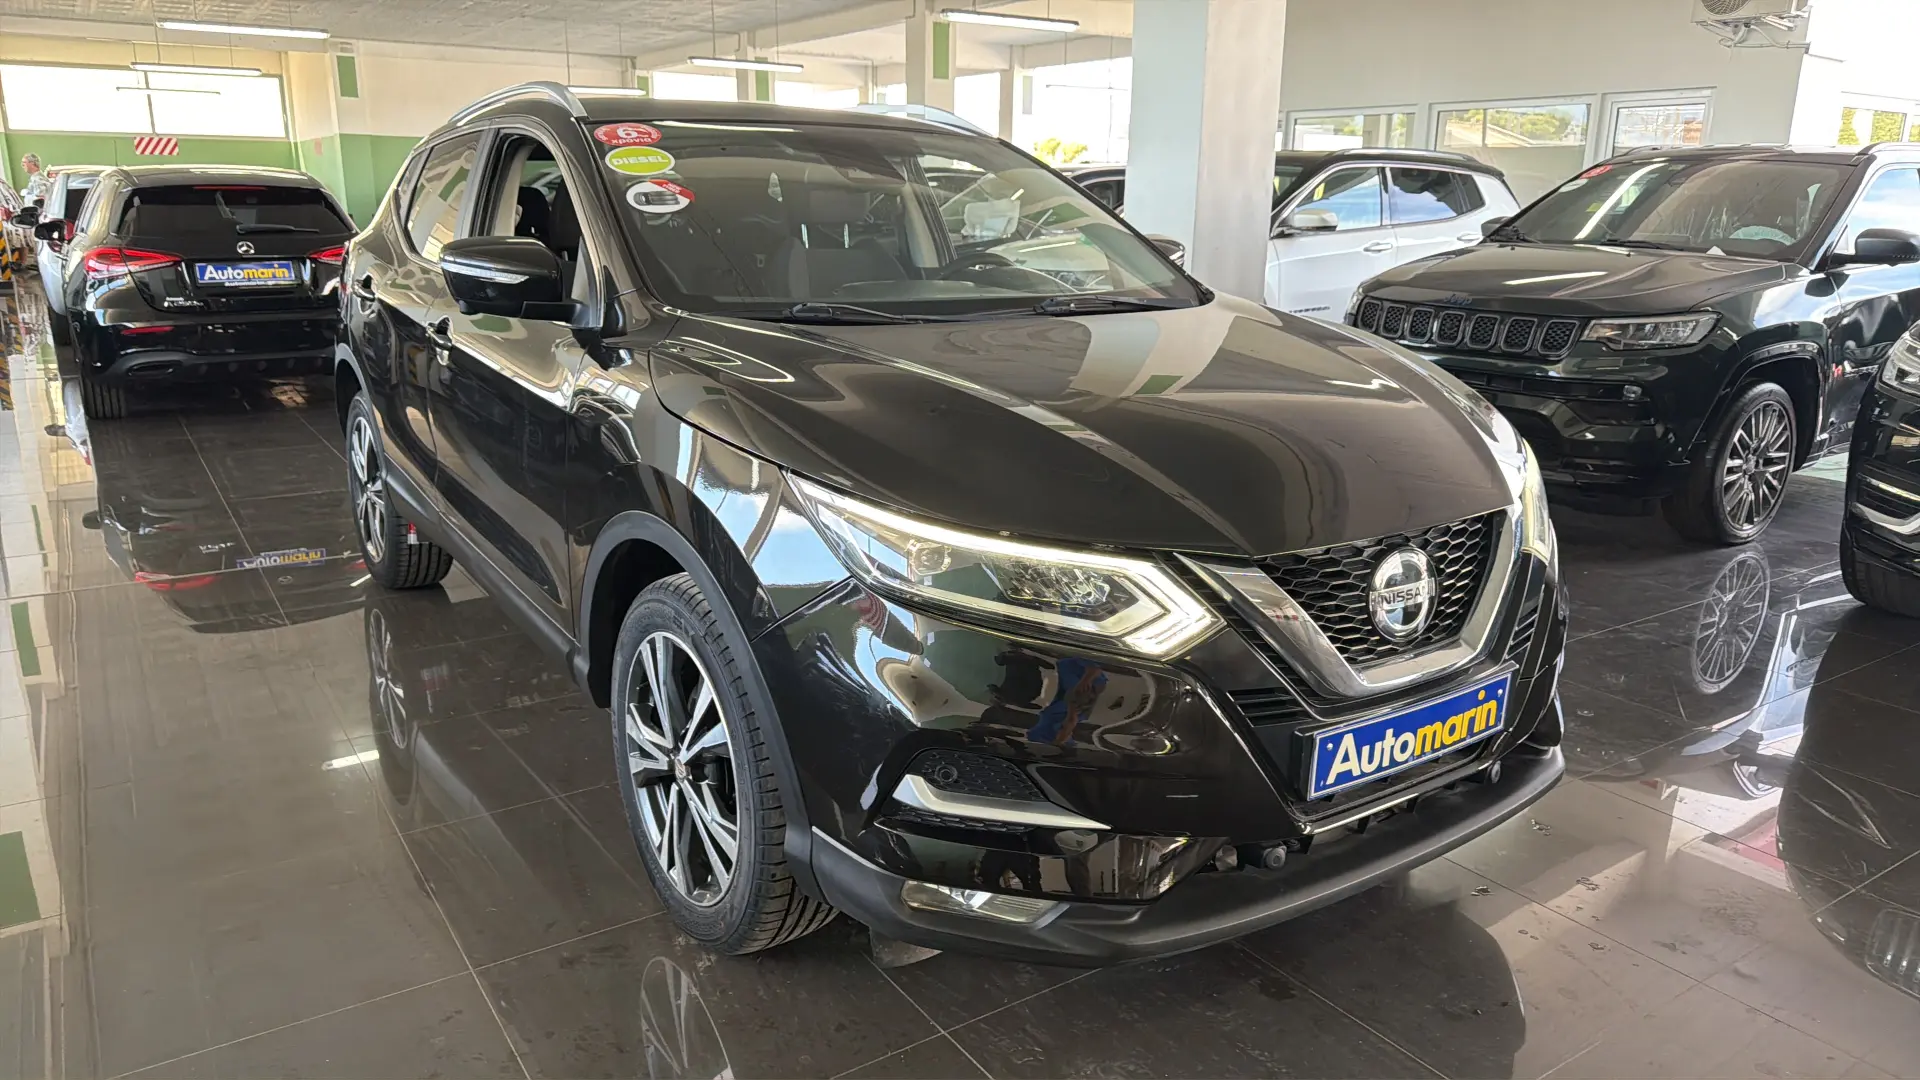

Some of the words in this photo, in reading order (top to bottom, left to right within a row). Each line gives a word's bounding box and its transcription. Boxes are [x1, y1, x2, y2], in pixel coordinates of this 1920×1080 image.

[611, 155, 669, 166] DIESEL
[204, 263, 289, 281] Automarin
[1326, 690, 1498, 784] Automarin
